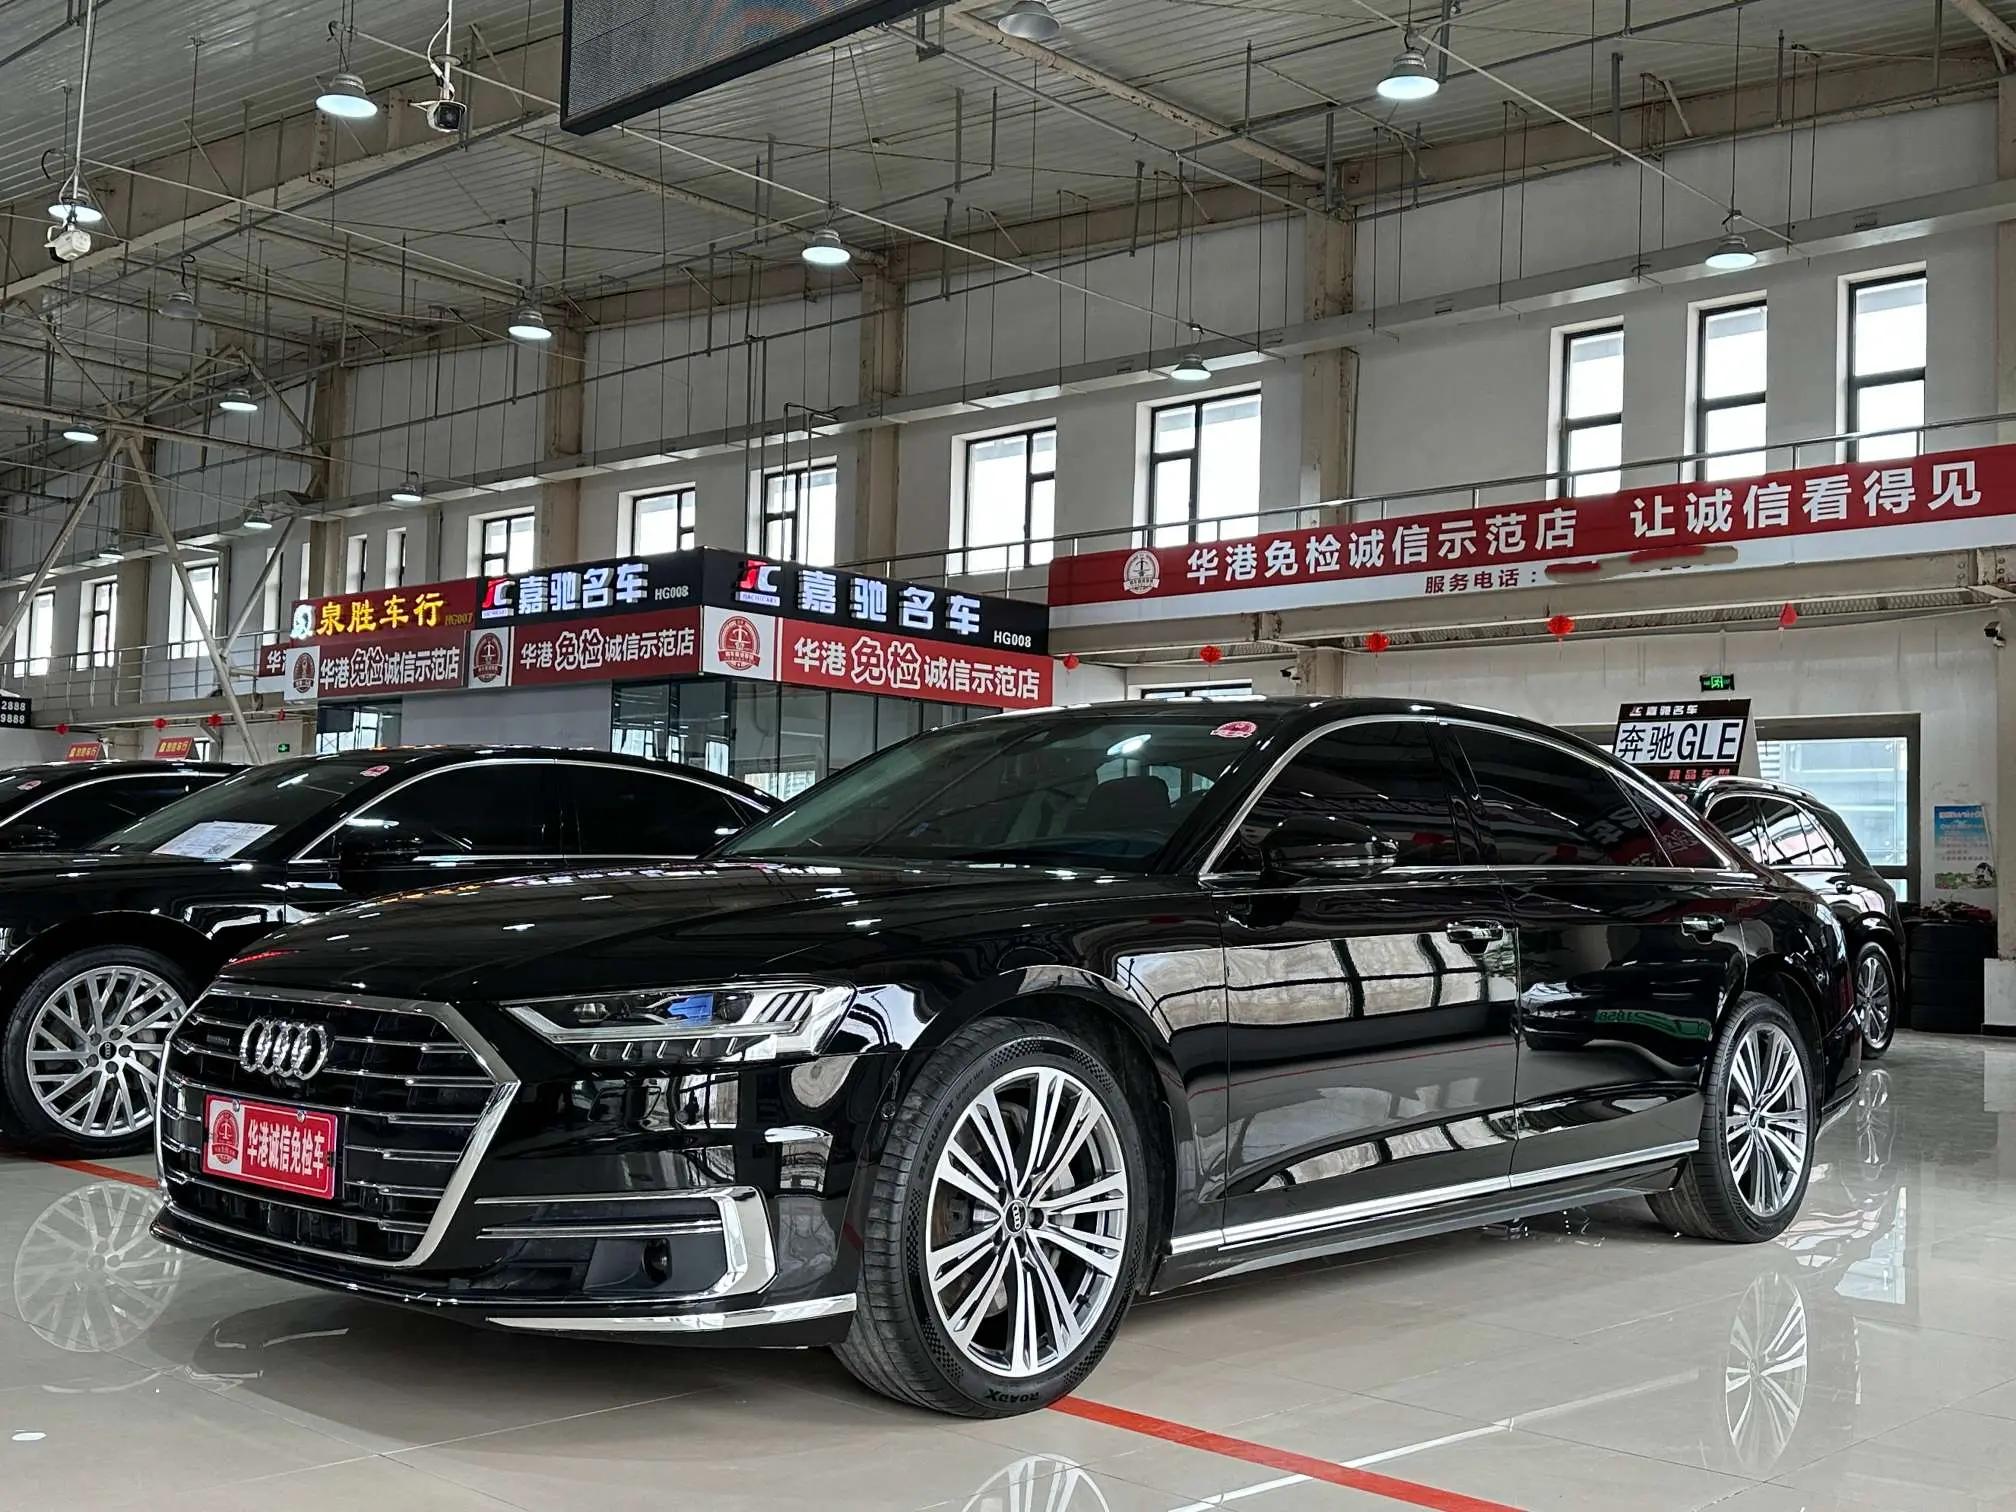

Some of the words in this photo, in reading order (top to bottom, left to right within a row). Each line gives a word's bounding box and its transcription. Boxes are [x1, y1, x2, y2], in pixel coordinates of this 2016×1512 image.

[1186, 507, 1578, 586] 华港免检诚信示范店
[1630, 460, 1983, 540] 让诚信看得见
[518, 563, 649, 615] 嘉驰名车
[655, 585, 689, 600] HG008
[798, 570, 981, 635] 嘉驰名车
[317, 592, 444, 636] 泉胜车行
[520, 627, 695, 672] 华港免检诚信示范店
[993, 630, 1032, 648] HG008
[319, 646, 461, 690] 华港免检诚信示范店
[794, 636, 1040, 700] 华港免检诚信示范店
[1618, 722, 1740, 761] 奔驰GLE
[247, 1118, 325, 1179] 华港诚信免检车
